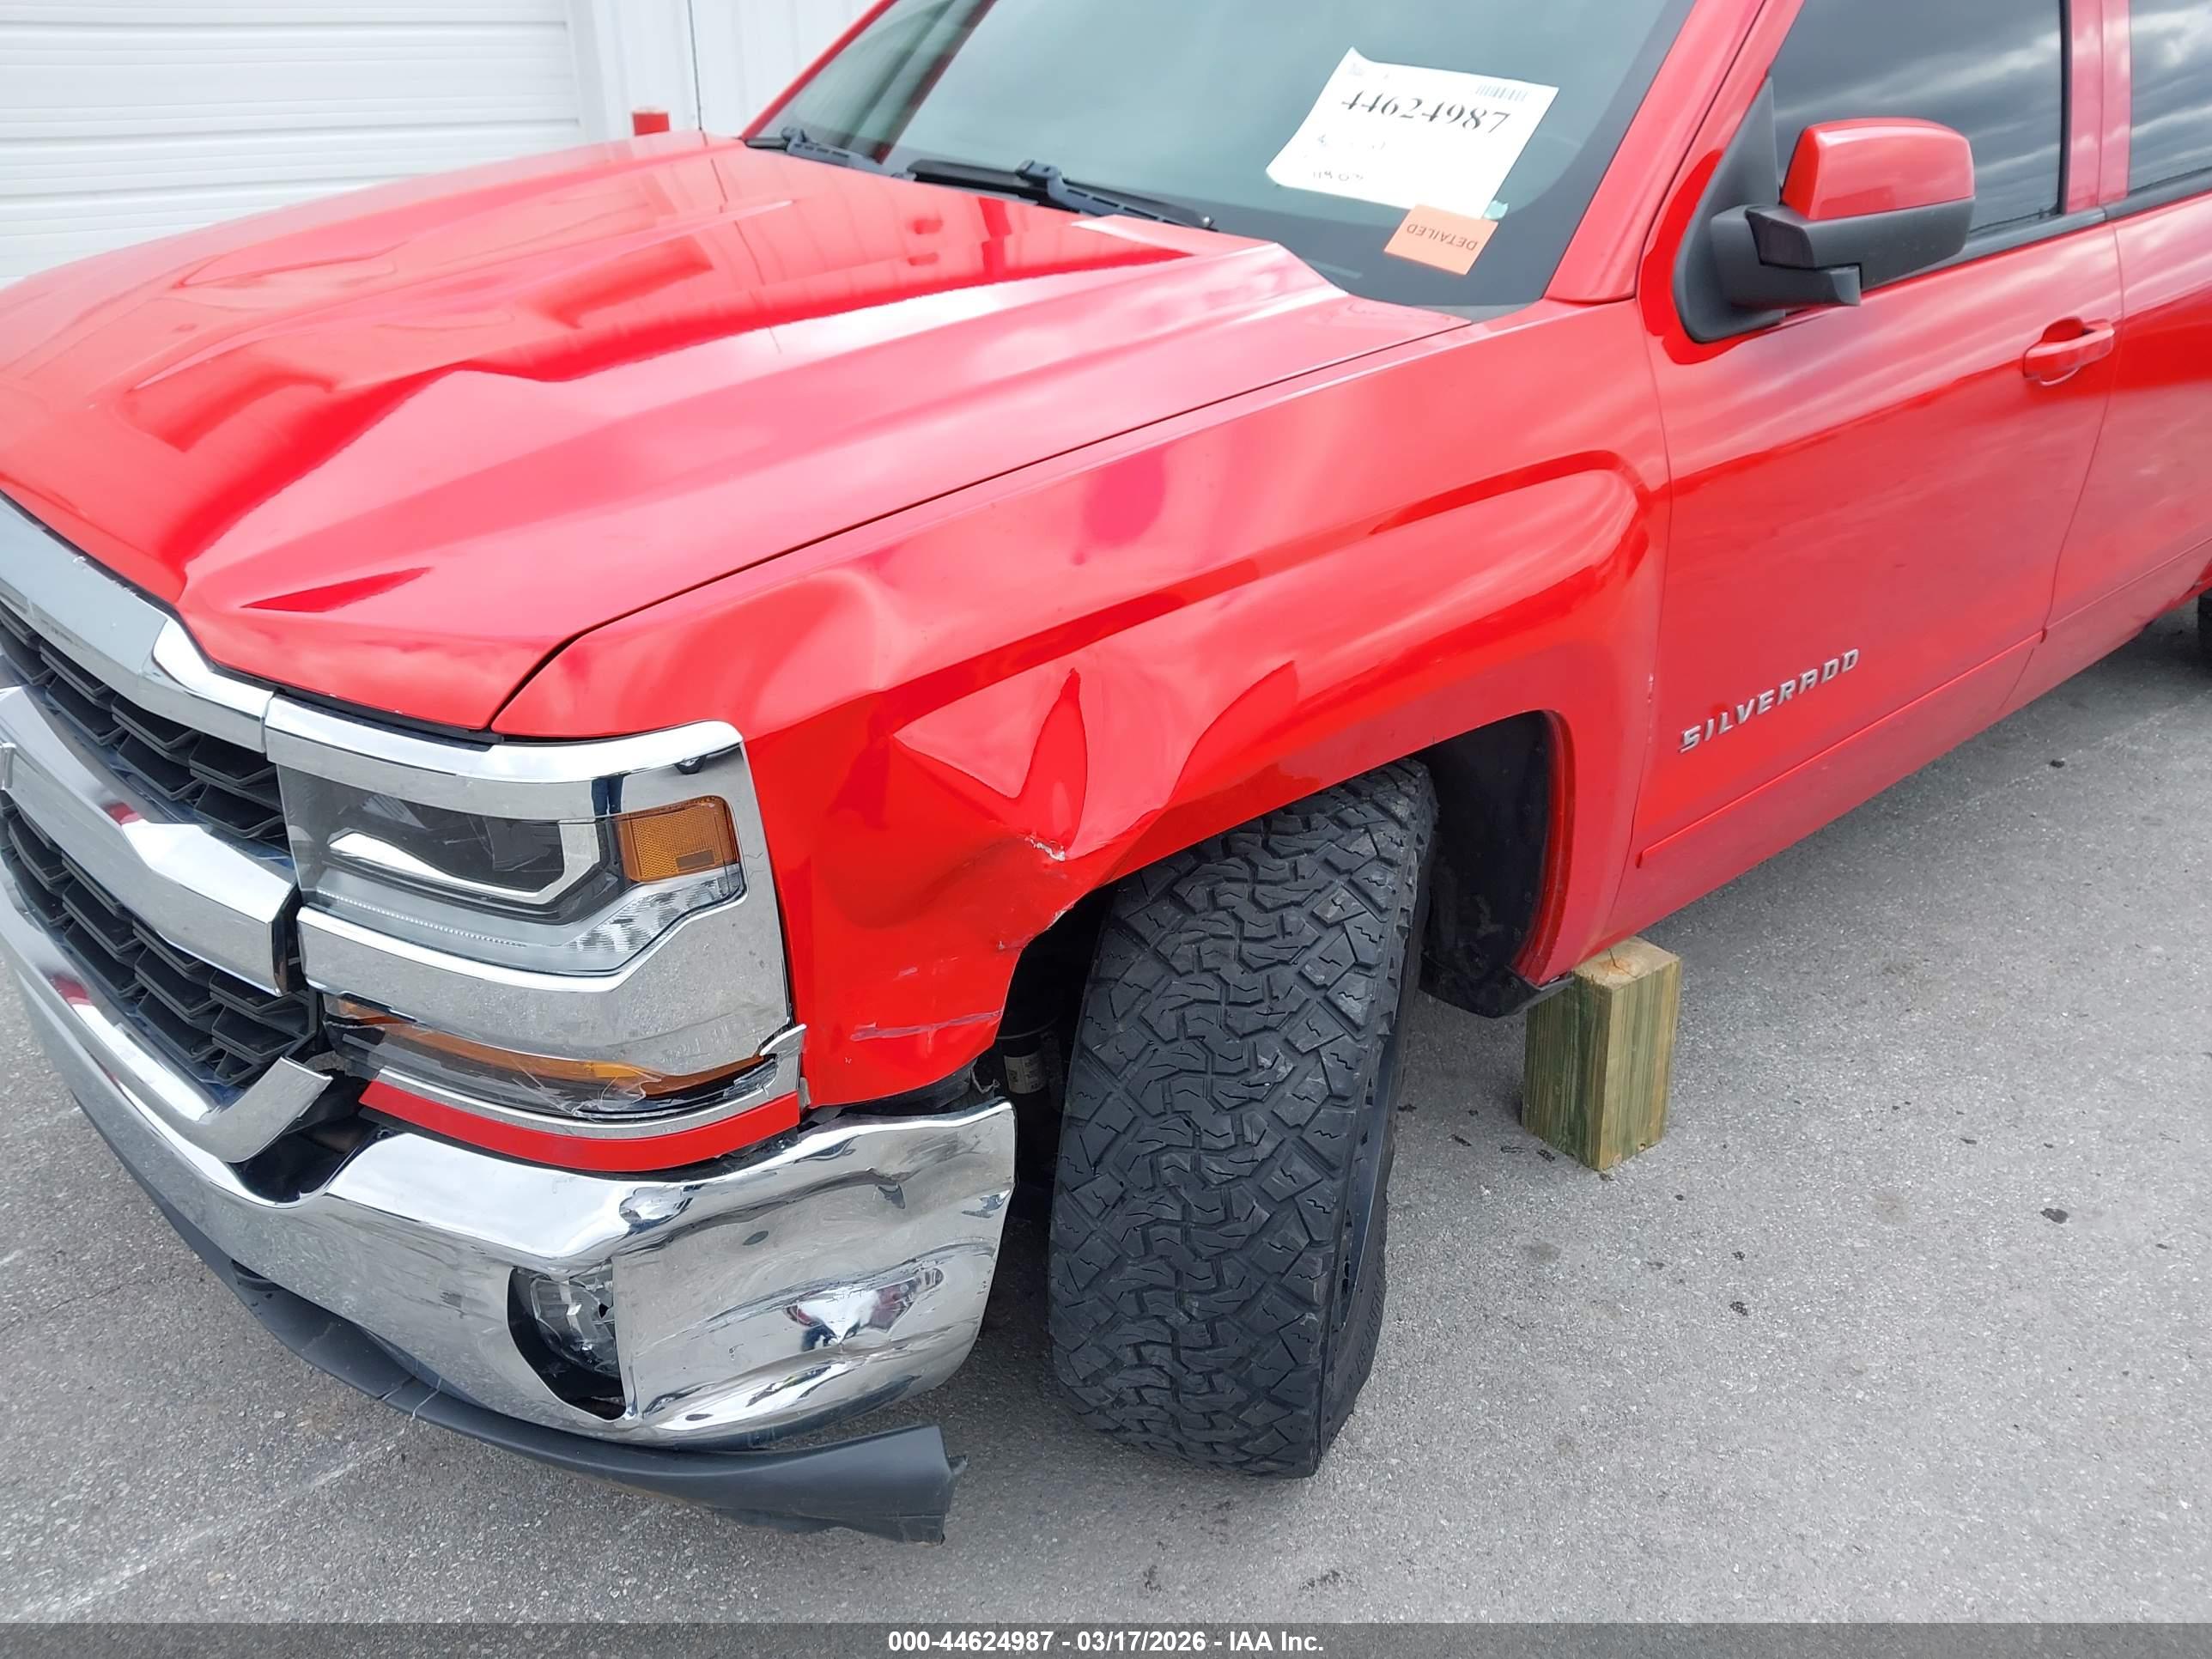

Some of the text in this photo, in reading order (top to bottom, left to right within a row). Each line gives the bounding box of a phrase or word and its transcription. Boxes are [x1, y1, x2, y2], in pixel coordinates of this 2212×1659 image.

[1340, 89, 1511, 134] 44624987
[1407, 222, 1480, 252] DETAILED
[1679, 648, 1860, 754] SILVERADO
